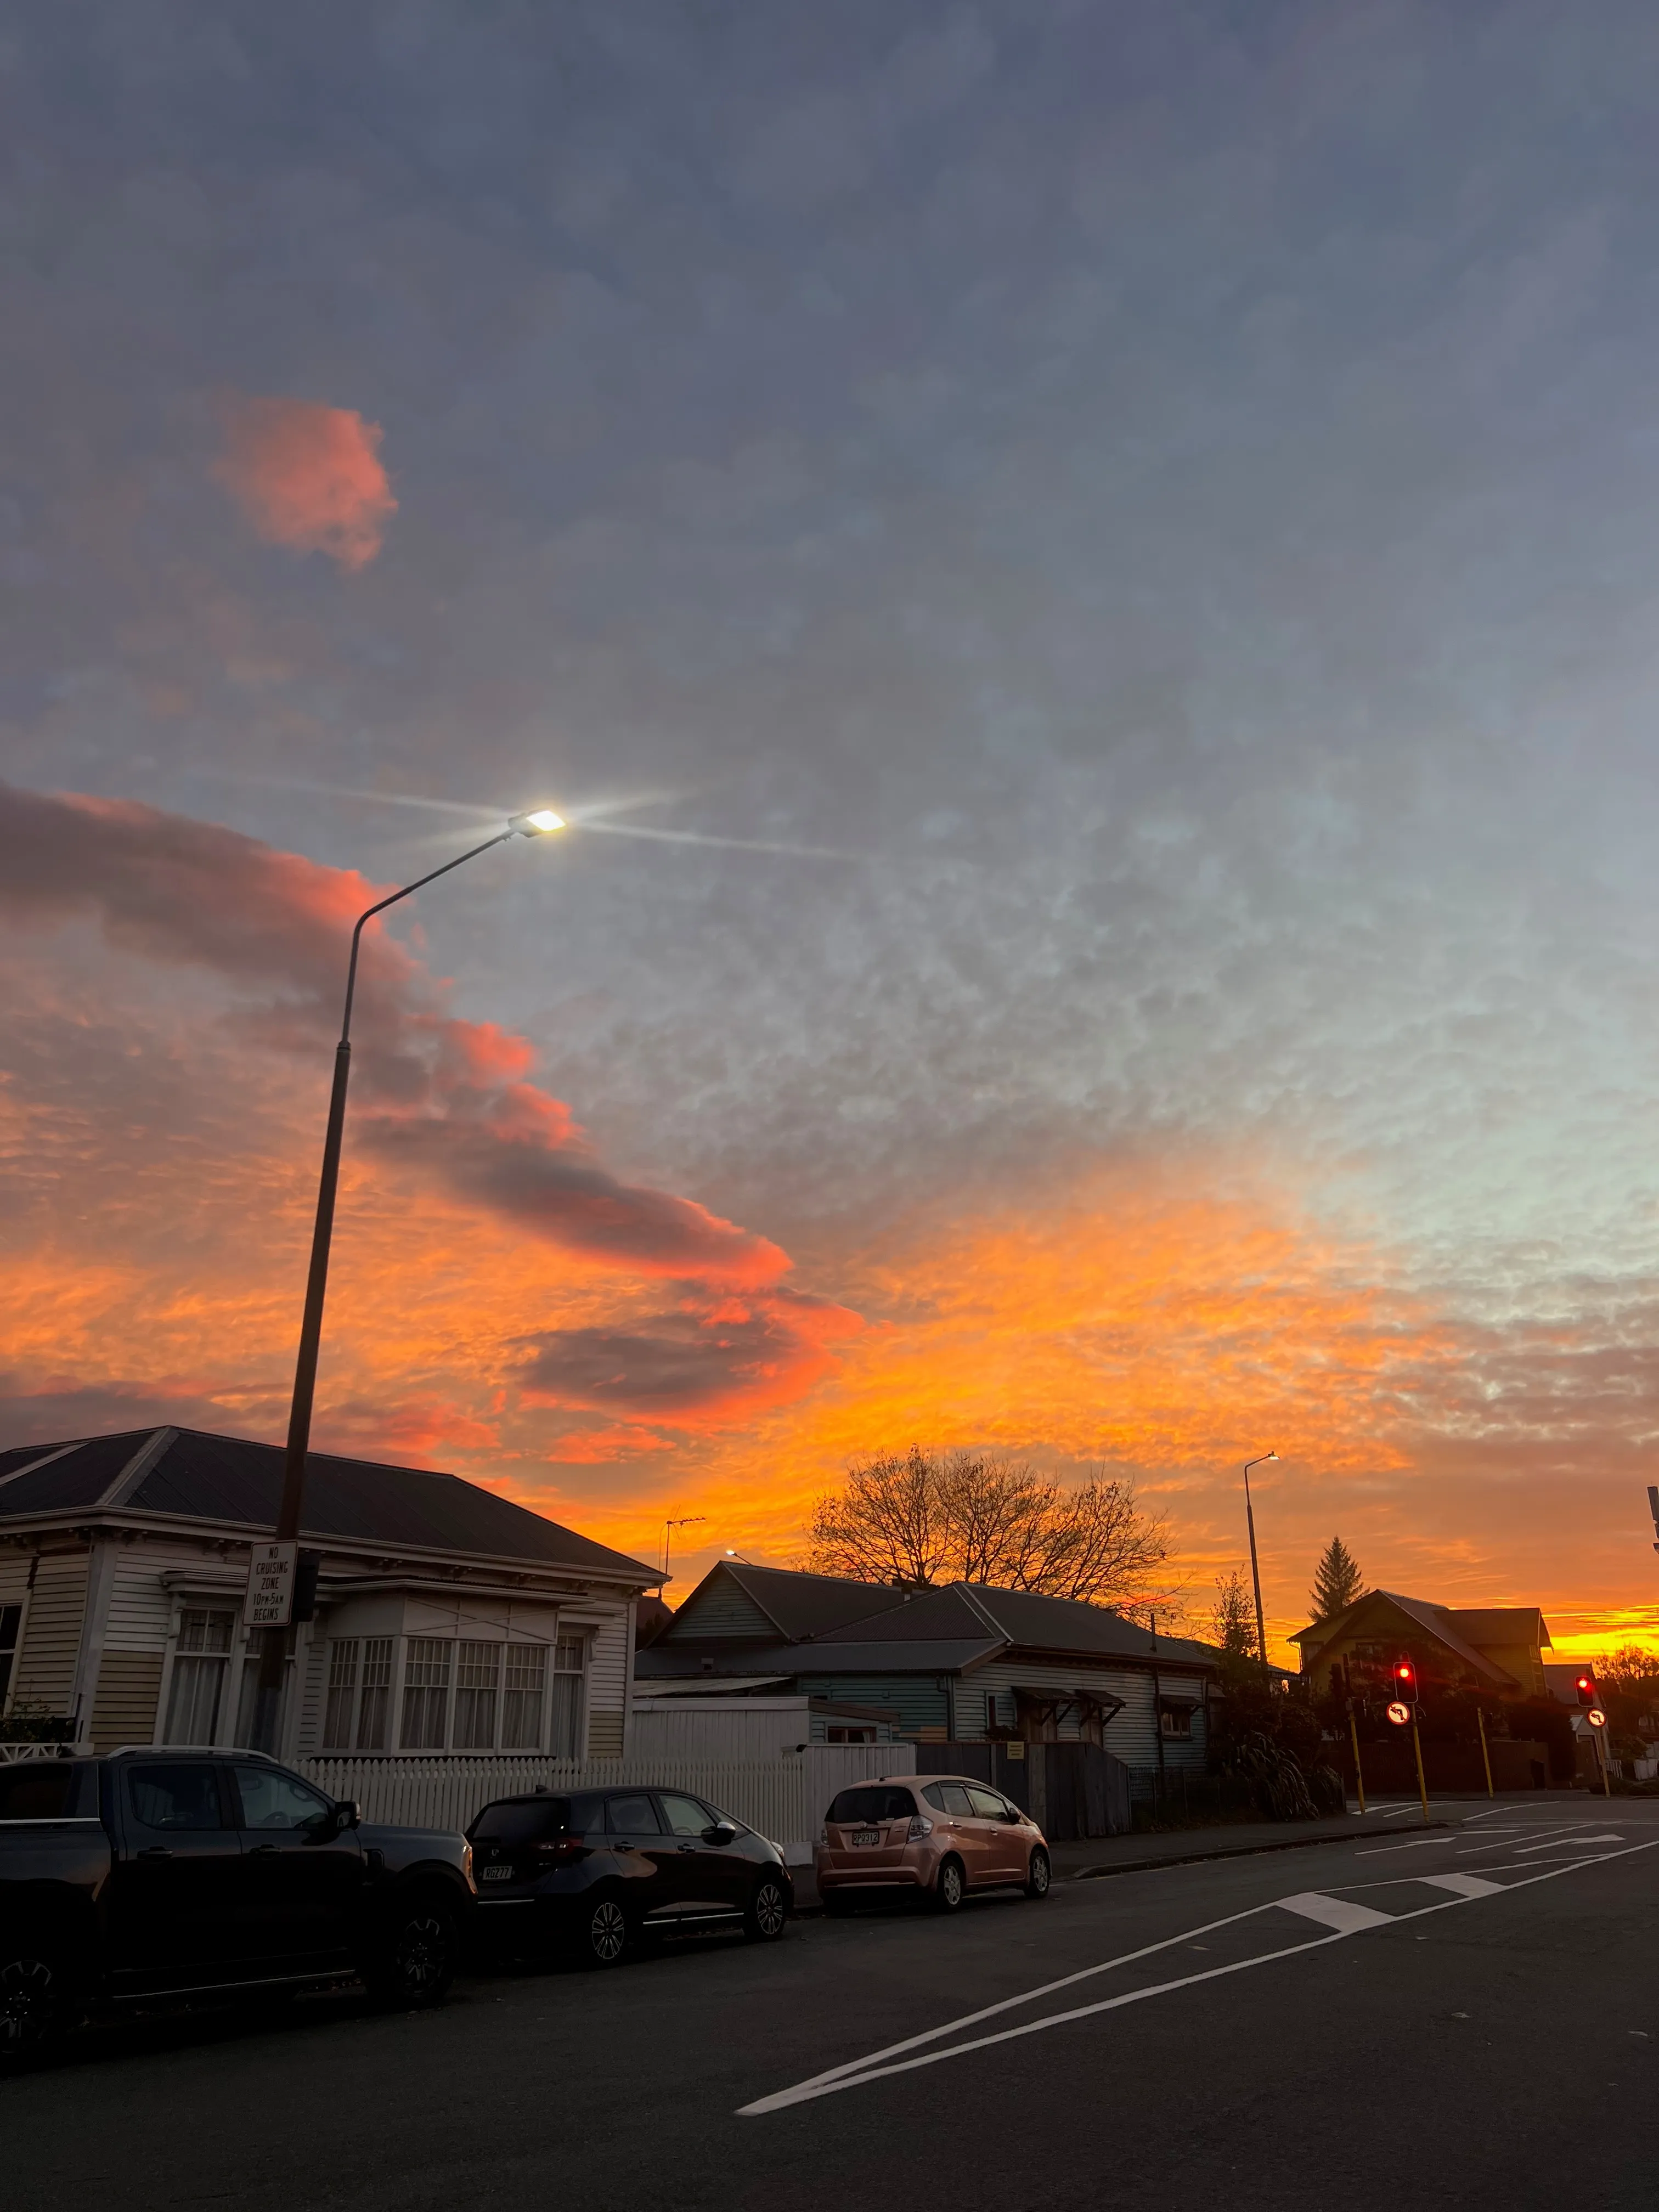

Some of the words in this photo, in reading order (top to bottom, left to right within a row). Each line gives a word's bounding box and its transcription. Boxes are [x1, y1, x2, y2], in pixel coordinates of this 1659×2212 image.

[268, 1547, 278, 1559] NO
[256, 1561, 288, 1575] CRUISING
[261, 1577, 280, 1590] ZONE
[253, 1593, 284, 1606] 10PM-5AM
[253, 1608, 279, 1621] BEGINS
